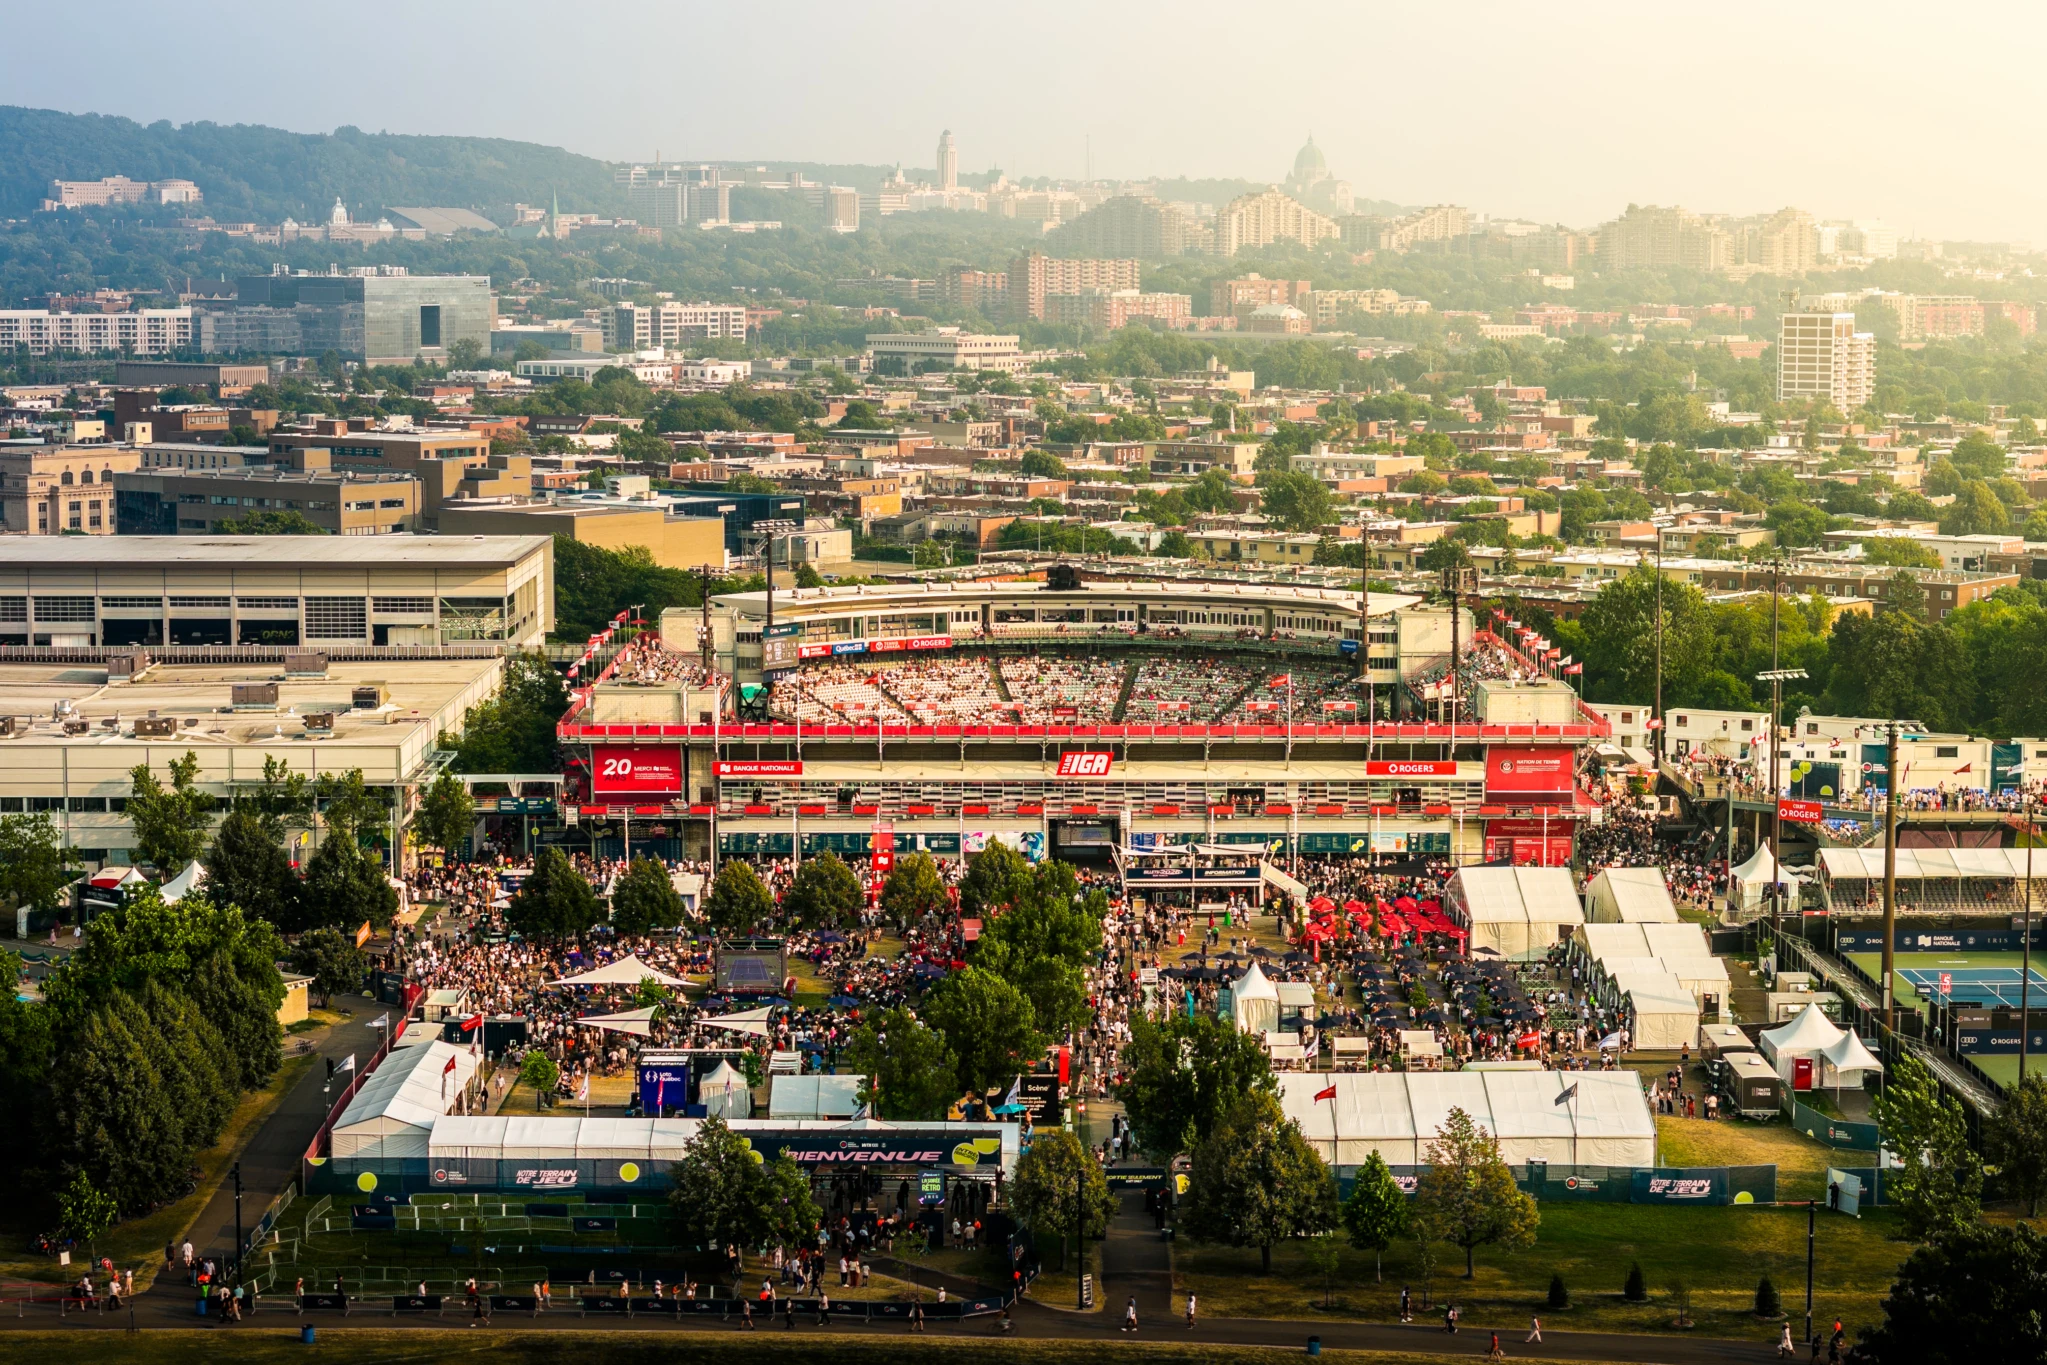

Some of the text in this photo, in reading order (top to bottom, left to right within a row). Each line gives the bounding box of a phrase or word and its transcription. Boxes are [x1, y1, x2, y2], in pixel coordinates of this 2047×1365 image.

[920, 639, 947, 647] ROGERS
[835, 644, 856, 653] Québec
[602, 758, 632, 775] 20
[1061, 754, 1074, 774] STADE
[1069, 754, 1109, 774] IGA
[1399, 764, 1434, 773] ROGERS
[604, 774, 627, 782] ANS
[1788, 810, 1819, 819] ROGERS
[787, 1151, 943, 1161] BIENVENUE
[922, 1183, 941, 1191] RÉTRO
[1672, 1179, 1711, 1187] TERRAIN
[1666, 1186, 1711, 1194] JEU
